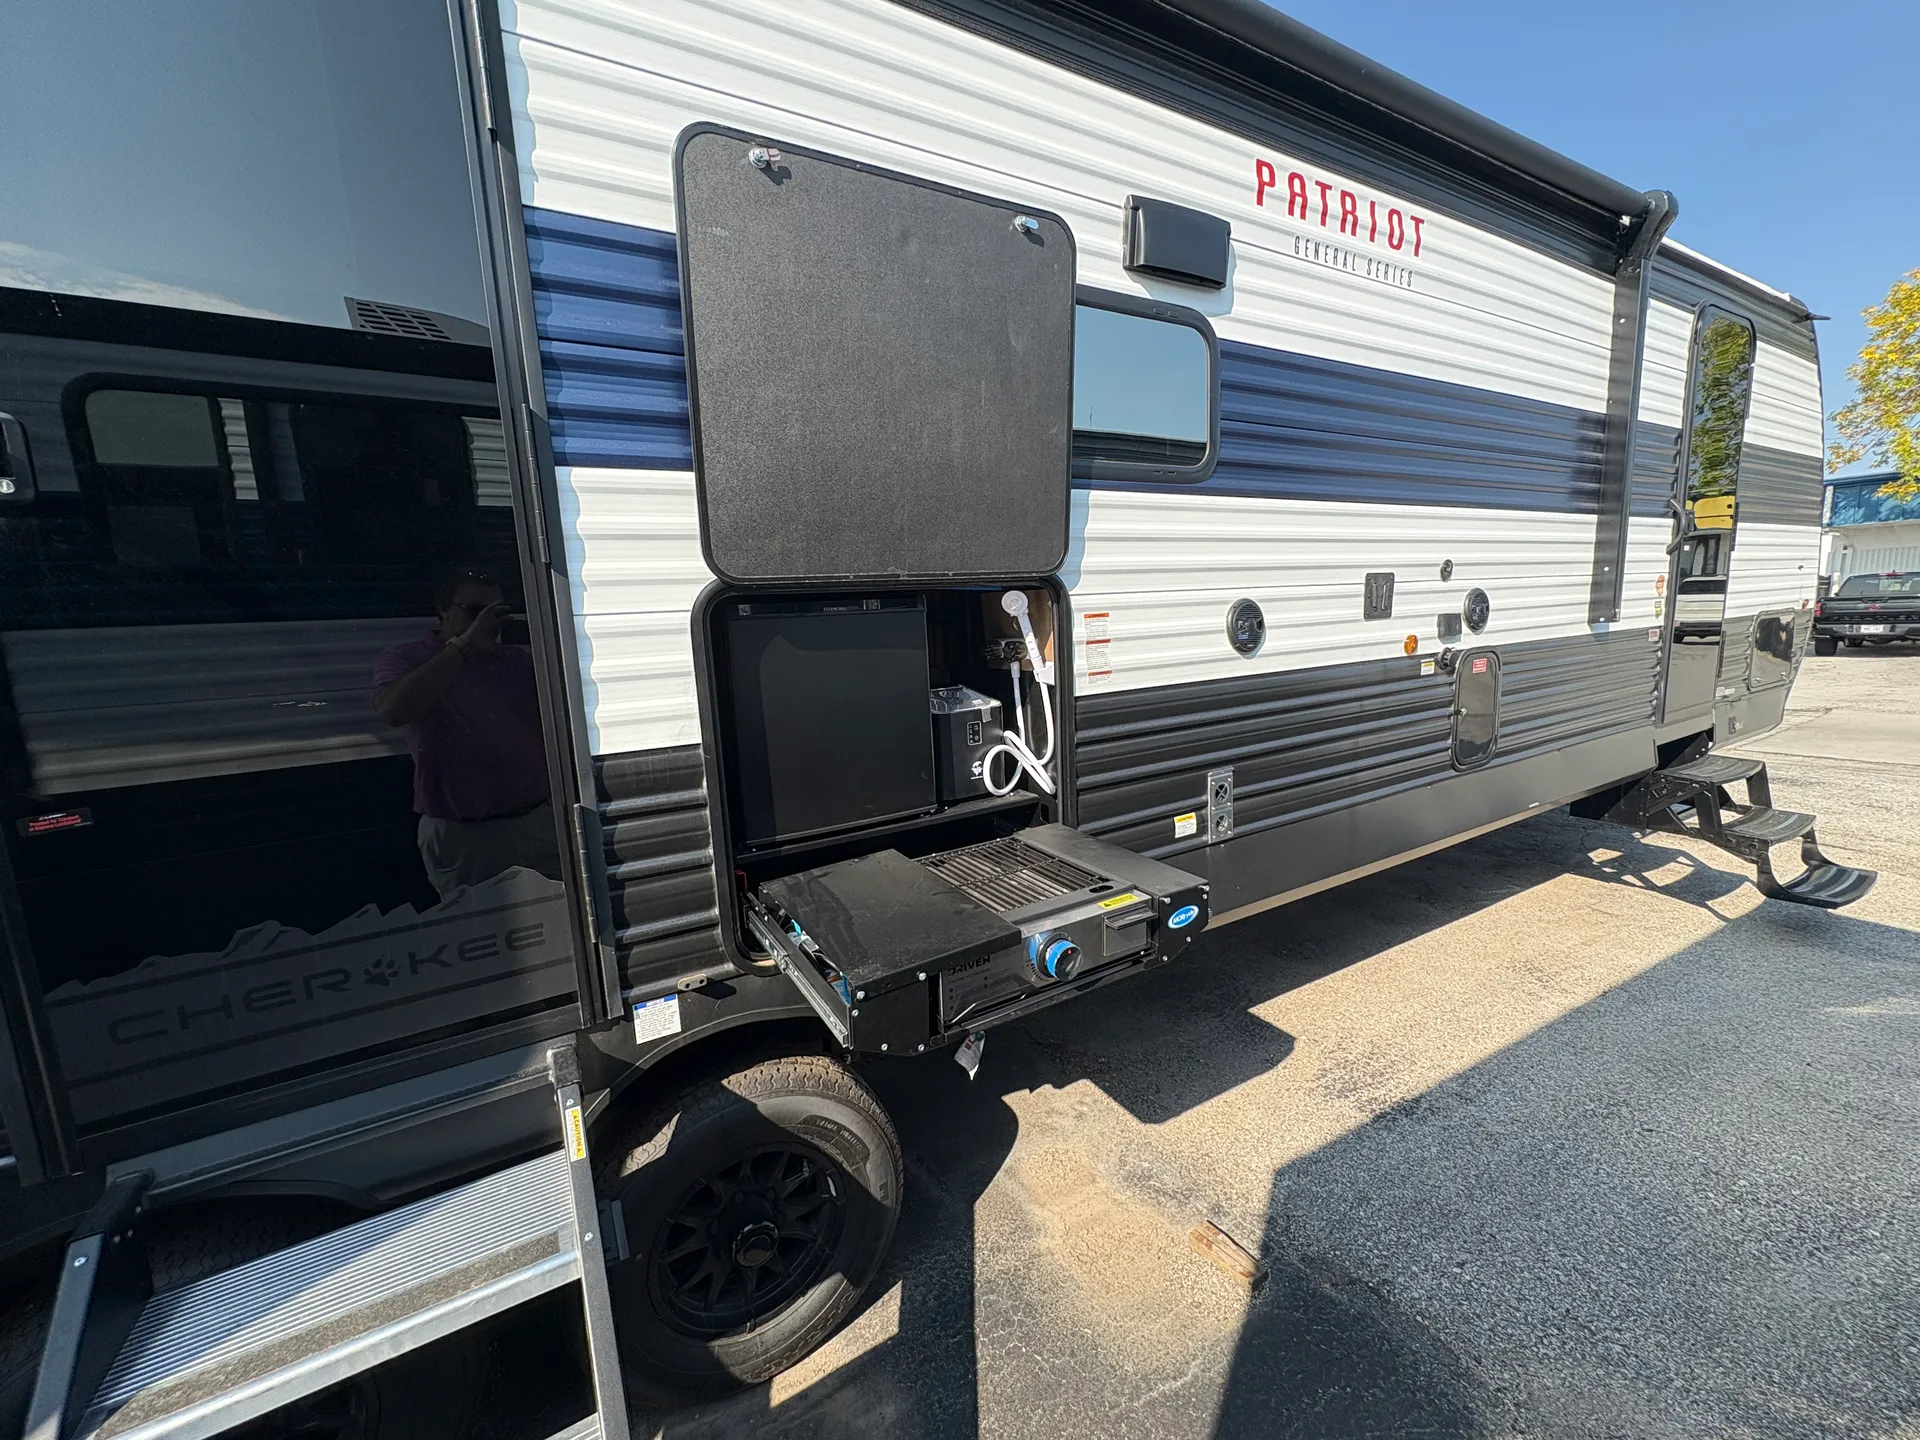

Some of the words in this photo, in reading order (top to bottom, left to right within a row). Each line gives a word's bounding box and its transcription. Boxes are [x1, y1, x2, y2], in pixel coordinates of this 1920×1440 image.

[1256, 158, 1425, 257] PATRIOT
[1294, 235, 1357, 272] GENERAL
[1366, 257, 1413, 288] SERIES
